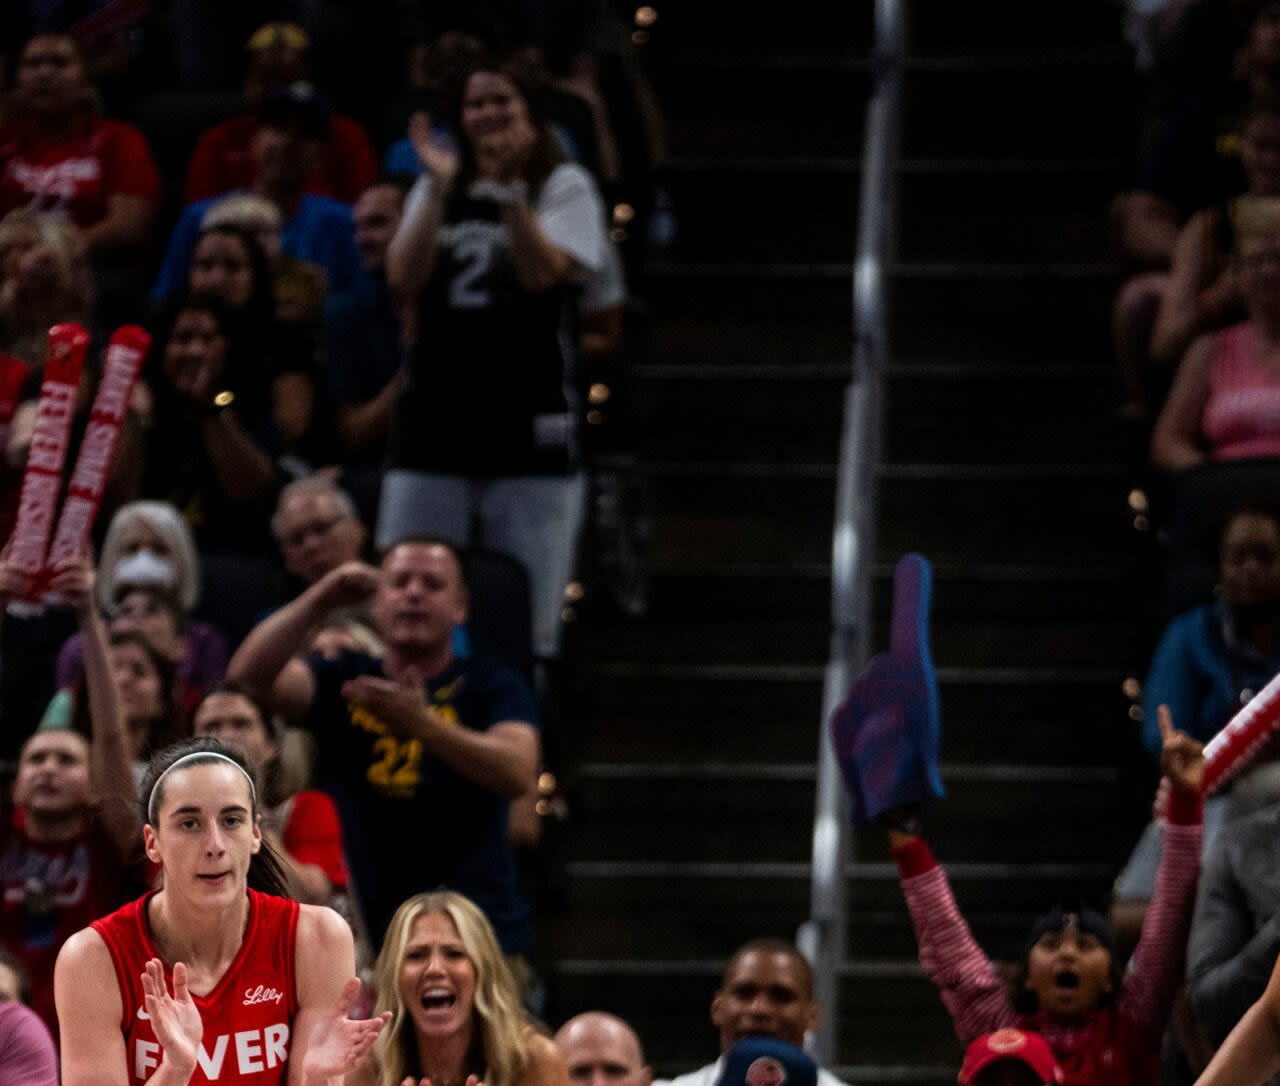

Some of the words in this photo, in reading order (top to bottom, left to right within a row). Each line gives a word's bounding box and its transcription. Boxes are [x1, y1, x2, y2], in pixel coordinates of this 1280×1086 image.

[25, 377, 80, 474] FEVER
[368, 736, 422, 786] 22
[242, 984, 284, 1006] Lilly
[135, 1022, 289, 1081] FVER
